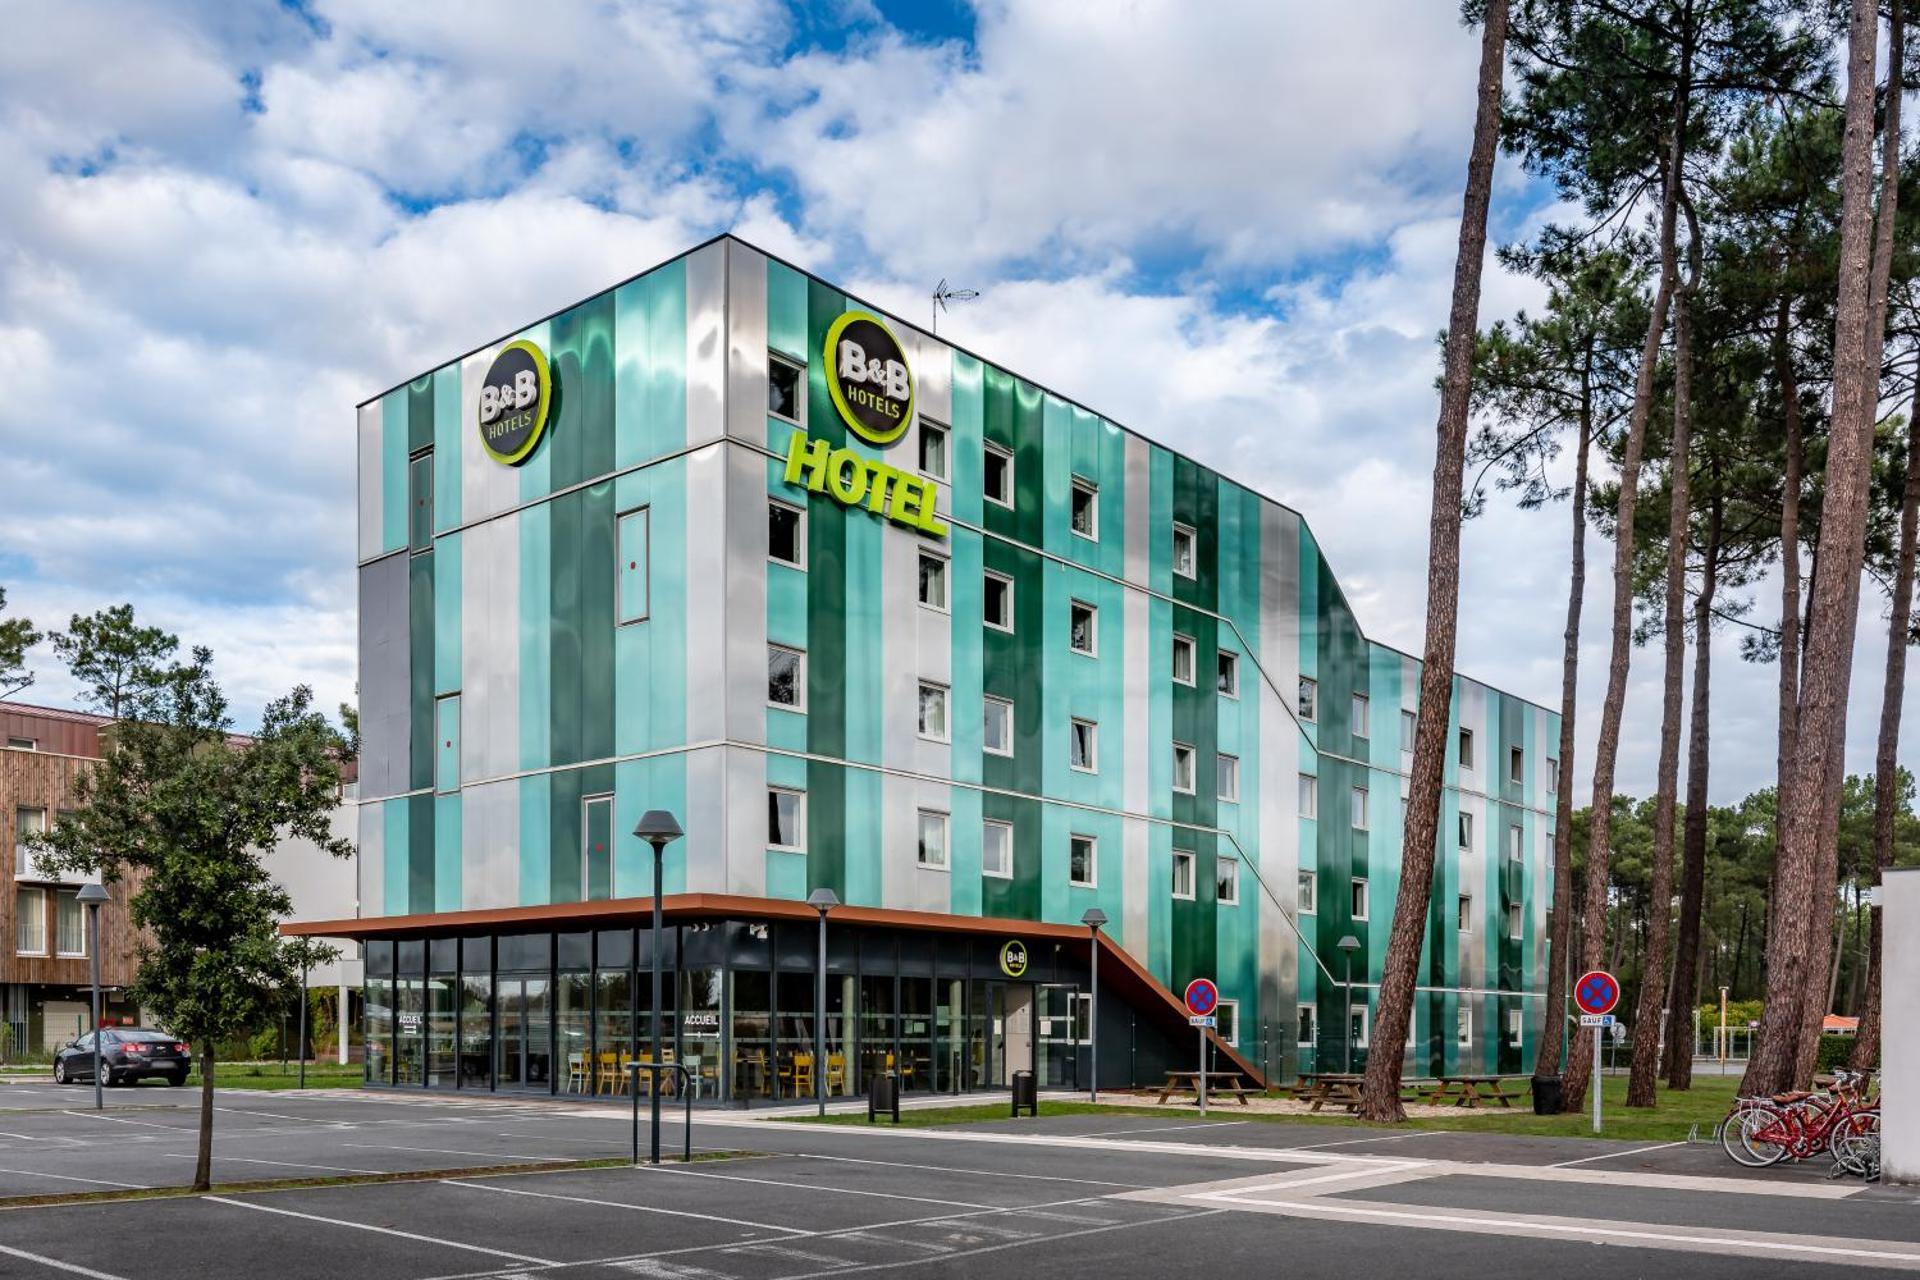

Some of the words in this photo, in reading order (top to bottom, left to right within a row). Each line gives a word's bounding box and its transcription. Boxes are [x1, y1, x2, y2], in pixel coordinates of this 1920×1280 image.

[839, 339, 910, 401] B&B
[480, 369, 537, 424] B&B
[847, 384, 900, 419] HOTELS
[489, 411, 532, 440] HOTELS
[784, 431, 949, 538] HOTEL
[1007, 951, 1024, 963] B&B
[684, 1014, 719, 1025] ACCUEIL
[1582, 1016, 1602, 1024] SAUF
